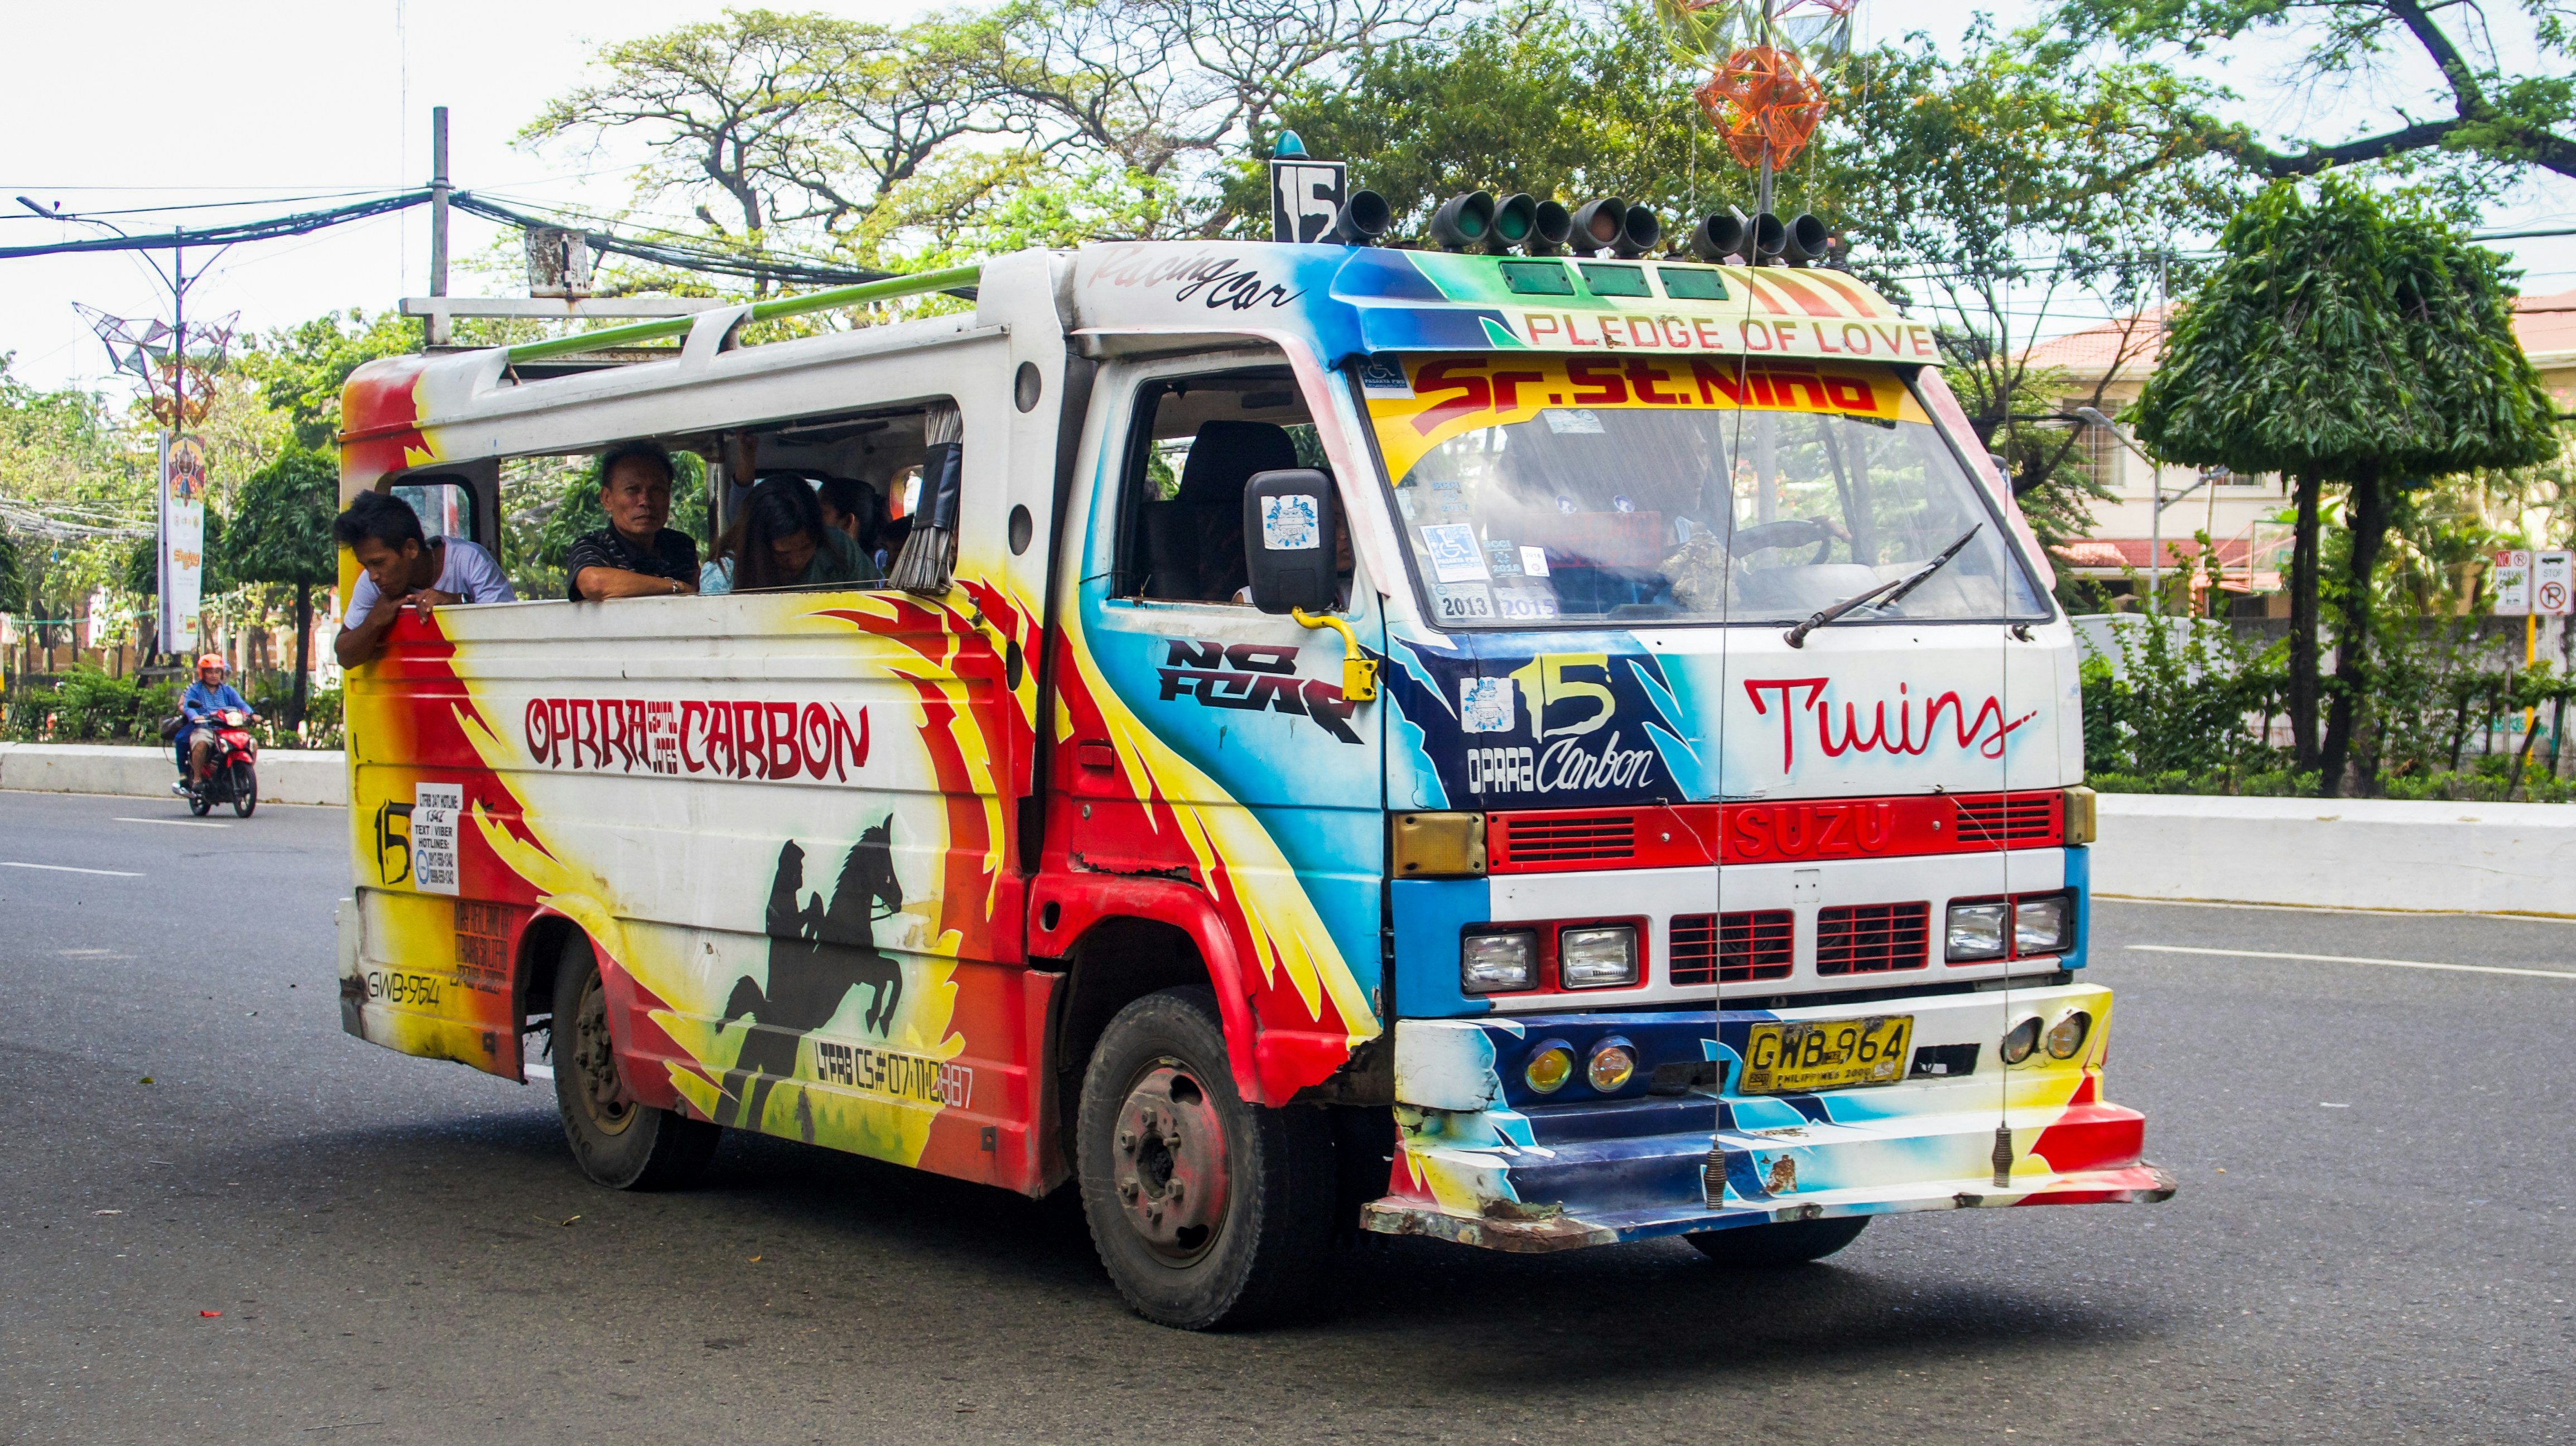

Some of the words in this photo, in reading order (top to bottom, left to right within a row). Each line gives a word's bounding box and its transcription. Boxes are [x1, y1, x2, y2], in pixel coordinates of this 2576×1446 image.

[1279, 166, 1337, 243] 15
[1087, 243, 1239, 302] Racing
[1206, 271, 1310, 311] Car
[1524, 312, 1723, 349] PLEDGE
[1739, 319, 1797, 351] OF
[1812, 321, 1934, 356] LOVE
[2544, 568, 2563, 578] STOP
[1443, 597, 1488, 616] 2013
[1501, 598, 1559, 616] 2015
[1165, 639, 1300, 676] NO
[1155, 667, 1365, 745] FEAR
[1509, 652, 1615, 744] 15
[526, 698, 651, 774] OPRRA
[679, 700, 870, 783] CARBON
[1744, 677, 2037, 775] Twins
[1535, 730, 1655, 793] Carbon
[374, 798, 415, 886] 15
[415, 825, 430, 835] TEXT
[435, 826, 452, 837] VIBER
[418, 837, 450, 850] HOTLINES:
[1716, 803, 1890, 860] ISUZU
[815, 1042, 853, 1086] LTFRB
[1752, 1029, 1826, 1070] GWB
[1837, 1023, 1905, 1065] 964
